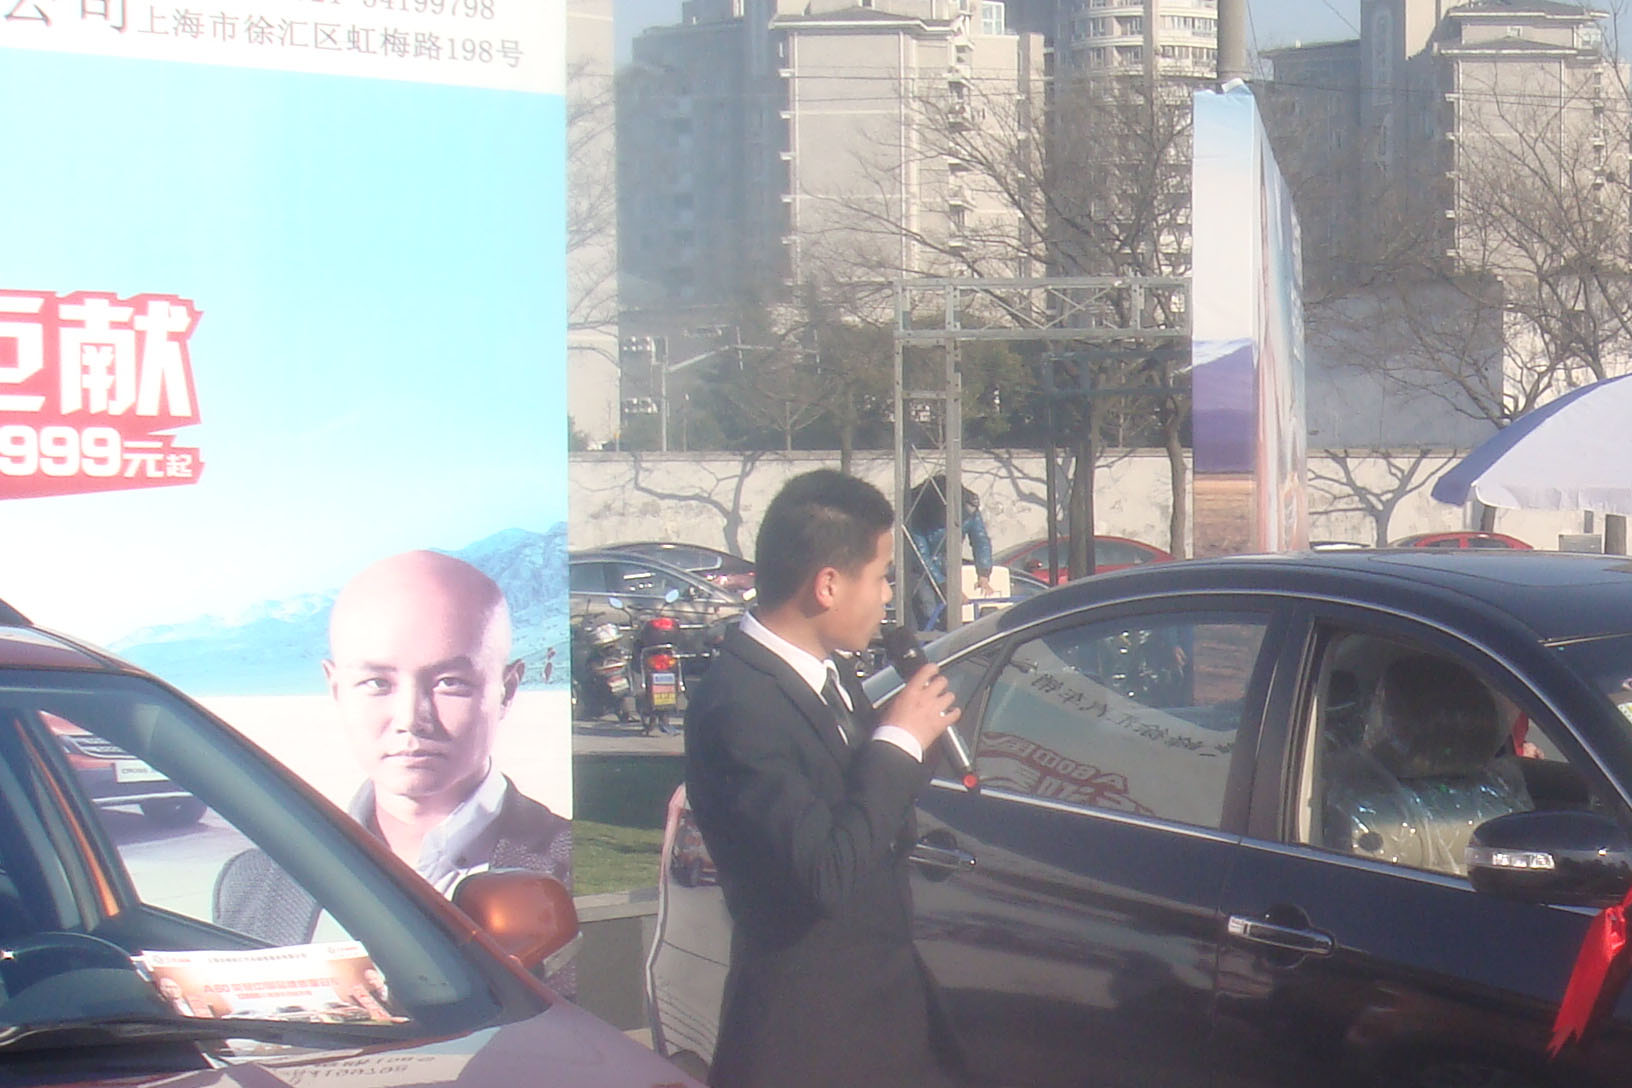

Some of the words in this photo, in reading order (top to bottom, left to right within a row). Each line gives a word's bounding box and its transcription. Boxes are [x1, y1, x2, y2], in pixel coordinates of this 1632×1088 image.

[137, 5, 524, 68] 上海市徐汇区虹梅路198号
